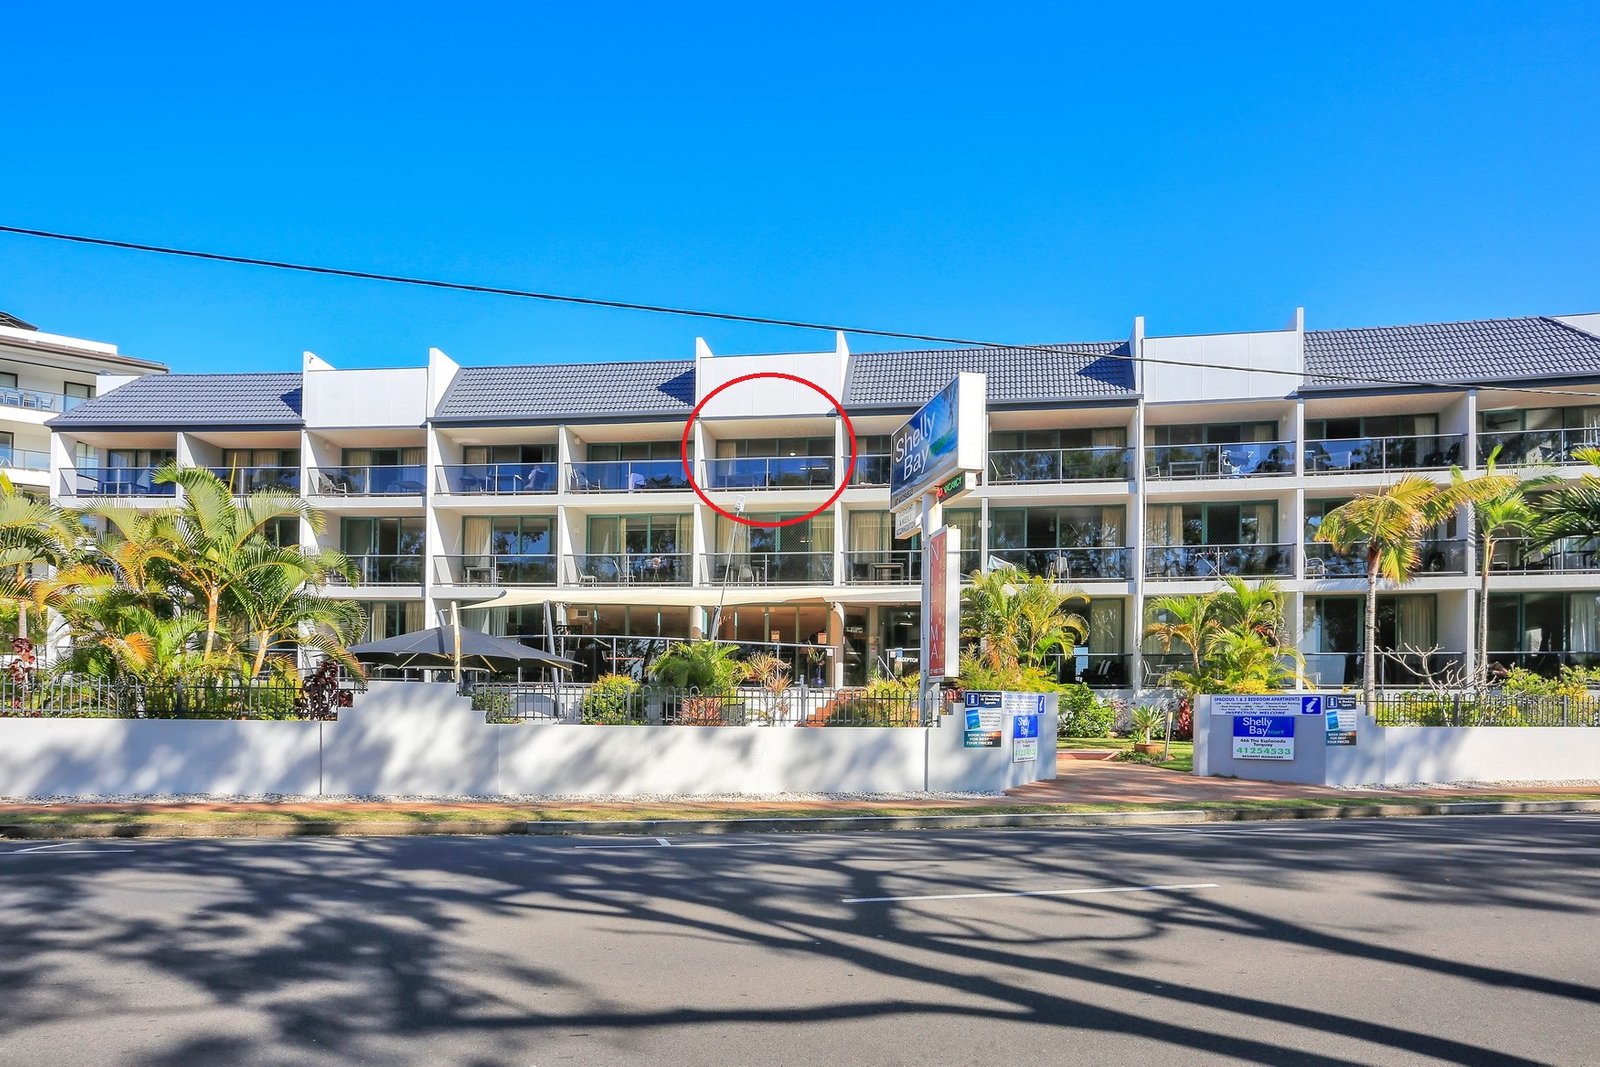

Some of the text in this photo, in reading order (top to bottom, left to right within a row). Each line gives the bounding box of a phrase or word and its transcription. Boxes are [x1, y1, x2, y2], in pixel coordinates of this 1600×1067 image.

[895, 411, 936, 463] Shelly
[903, 444, 930, 481] Bay
[1018, 716, 1030, 728] Shelly
[1242, 717, 1273, 728] Shelly
[1020, 726, 1029, 737] Bay
[1249, 726, 1269, 737] Bay
[1236, 747, 1291, 755] 41254533
